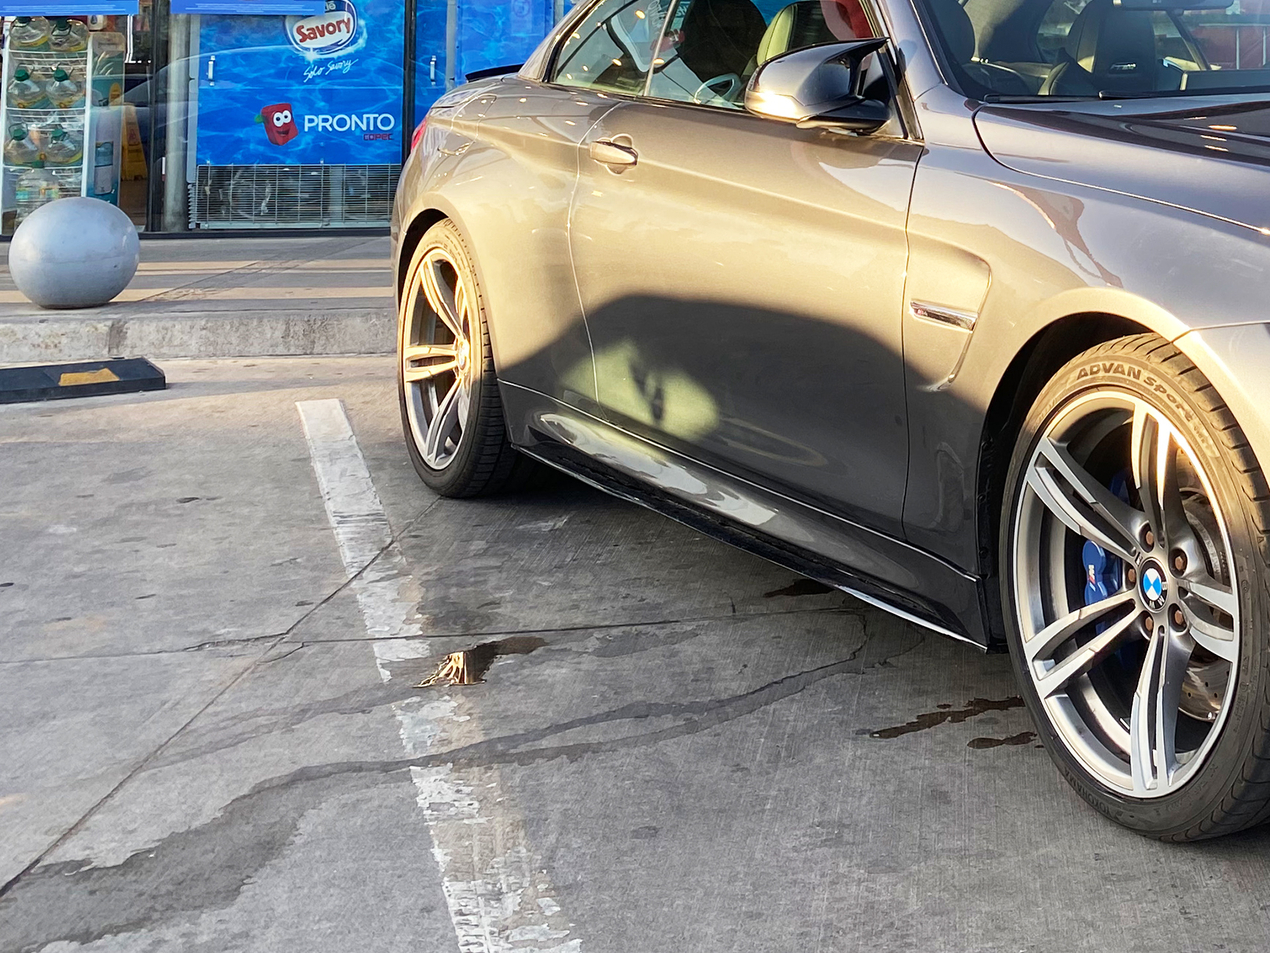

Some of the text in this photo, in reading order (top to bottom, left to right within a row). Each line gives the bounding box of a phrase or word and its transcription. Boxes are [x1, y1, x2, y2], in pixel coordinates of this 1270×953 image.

[296, 17, 350, 43] Savory
[304, 114, 395, 132] PRONTO
[1076, 362, 1142, 380] ADVAN
